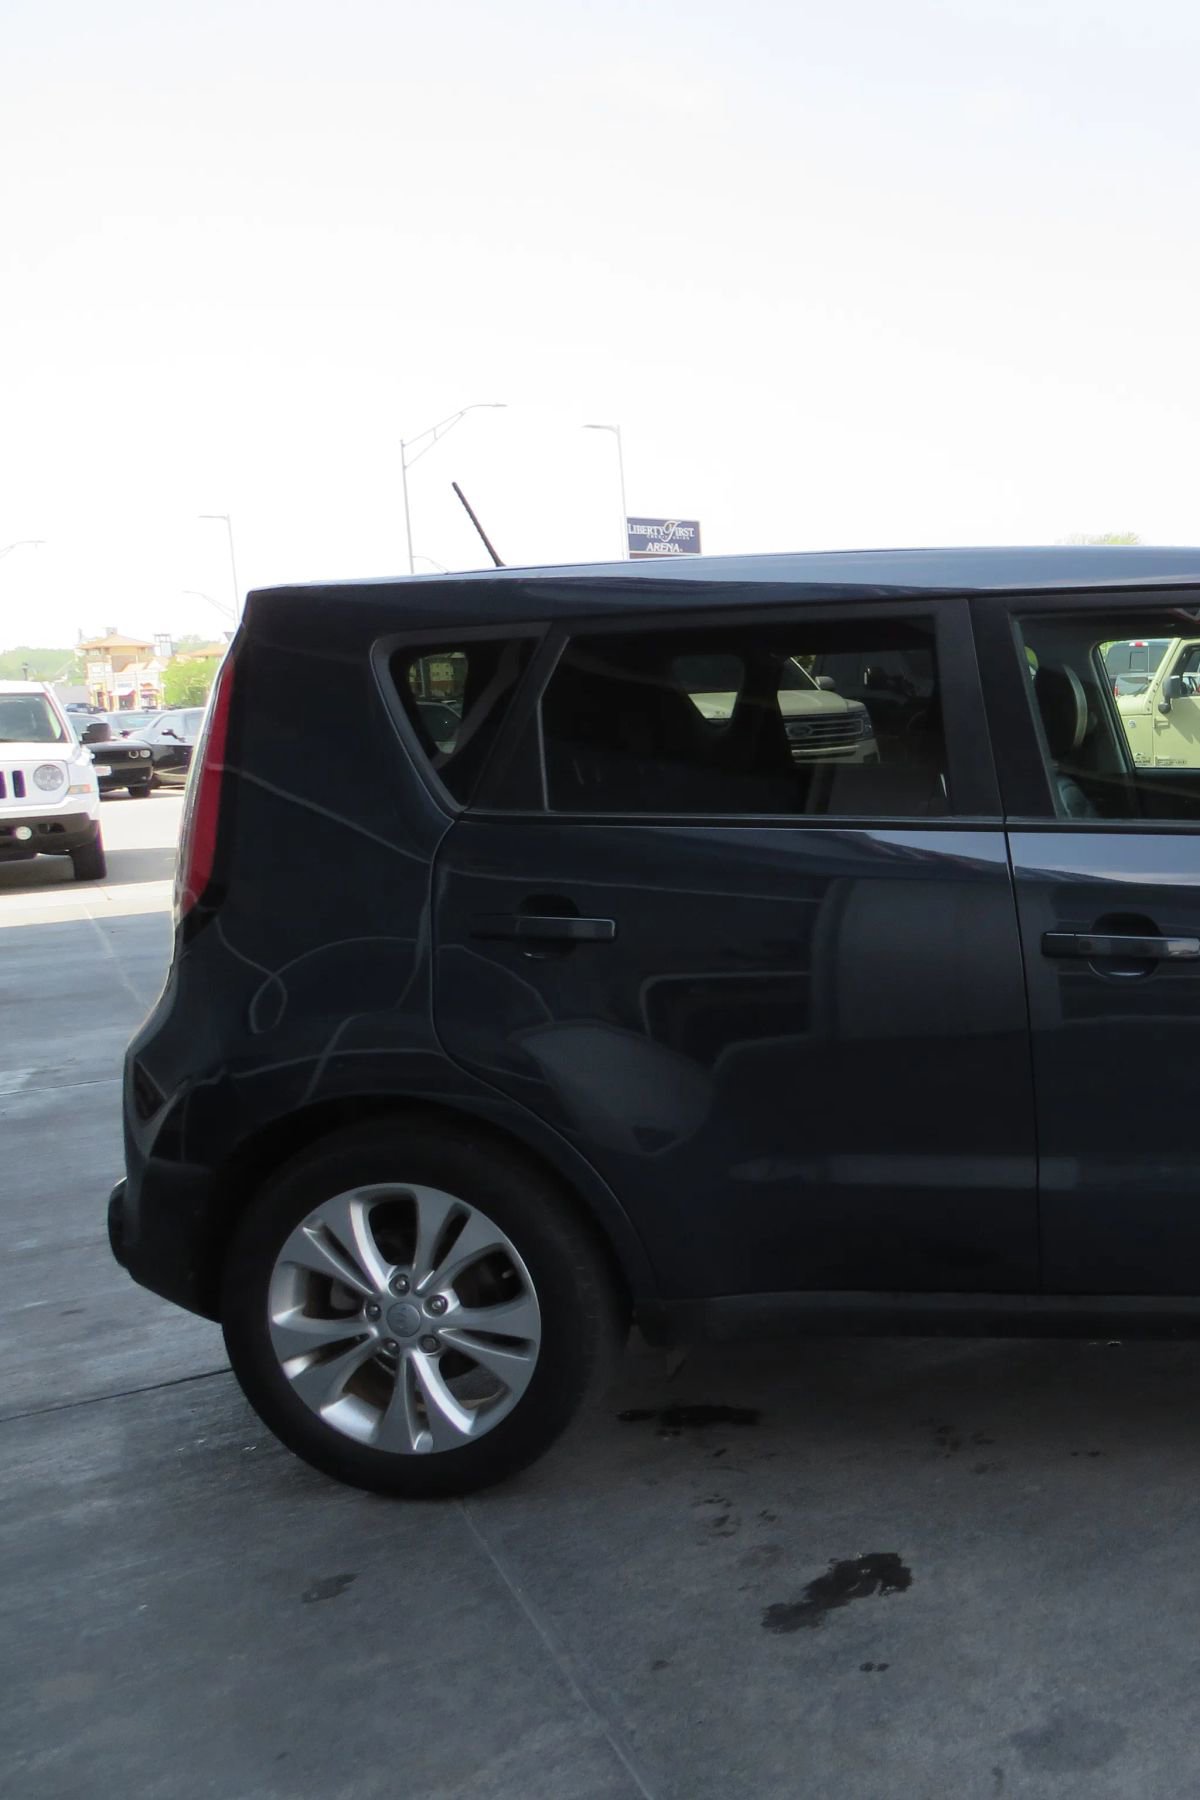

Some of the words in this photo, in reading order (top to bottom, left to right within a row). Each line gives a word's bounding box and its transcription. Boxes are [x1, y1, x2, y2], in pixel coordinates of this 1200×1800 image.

[628, 523, 664, 535] LIBERTY
[662, 520, 695, 542] FIRST
[646, 542, 680, 552] ARENA
